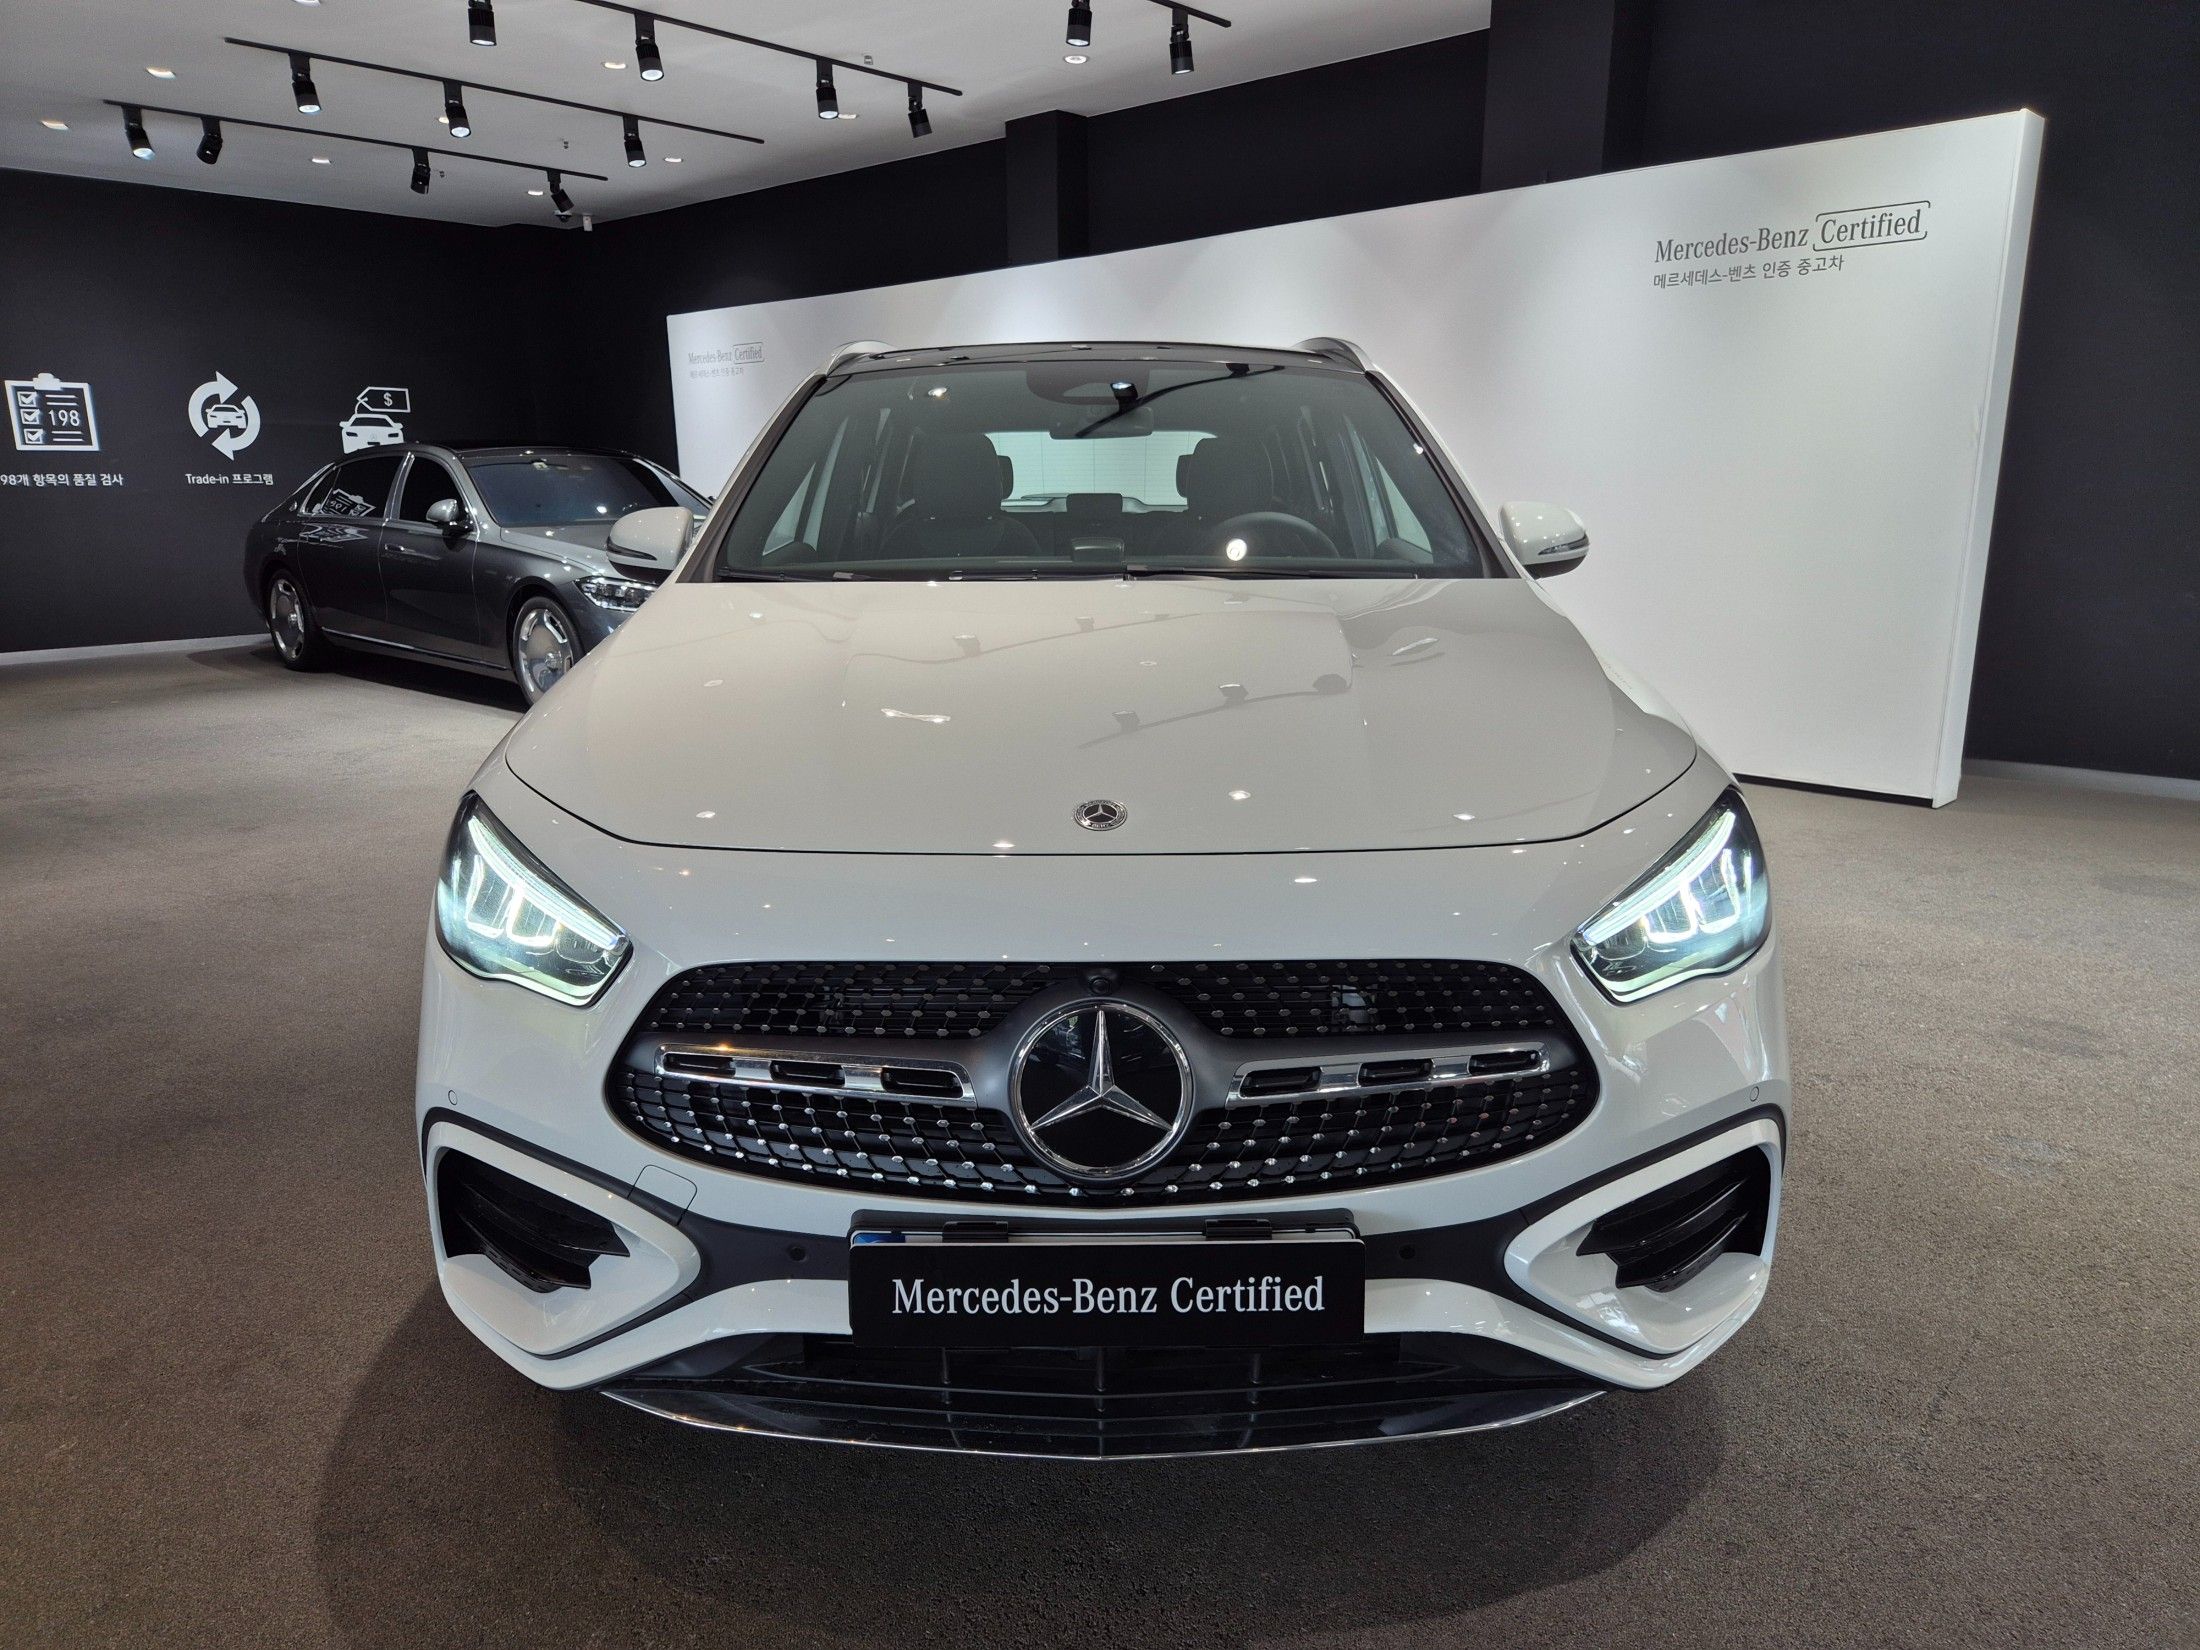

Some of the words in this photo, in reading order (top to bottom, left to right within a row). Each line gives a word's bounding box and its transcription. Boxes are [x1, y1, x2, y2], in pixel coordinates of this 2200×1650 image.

[1654, 227, 1809, 263] Mercedes-Benz
[1820, 209, 1921, 244] Certified
[1653, 263, 1756, 289] 메르세데스-벤츠
[1762, 260, 1792, 279] 인증
[1797, 254, 1845, 273] 중고차
[48, 409, 81, 427] 198
[32, 473, 70, 487] 항목의
[73, 473, 97, 487] 품질
[100, 473, 124, 486] 검사
[185, 473, 230, 485] Trade-in
[232, 473, 274, 486] 프로그램
[891, 1277, 1158, 1315] Mercedes-Benz
[1170, 1275, 1325, 1313] Certified
